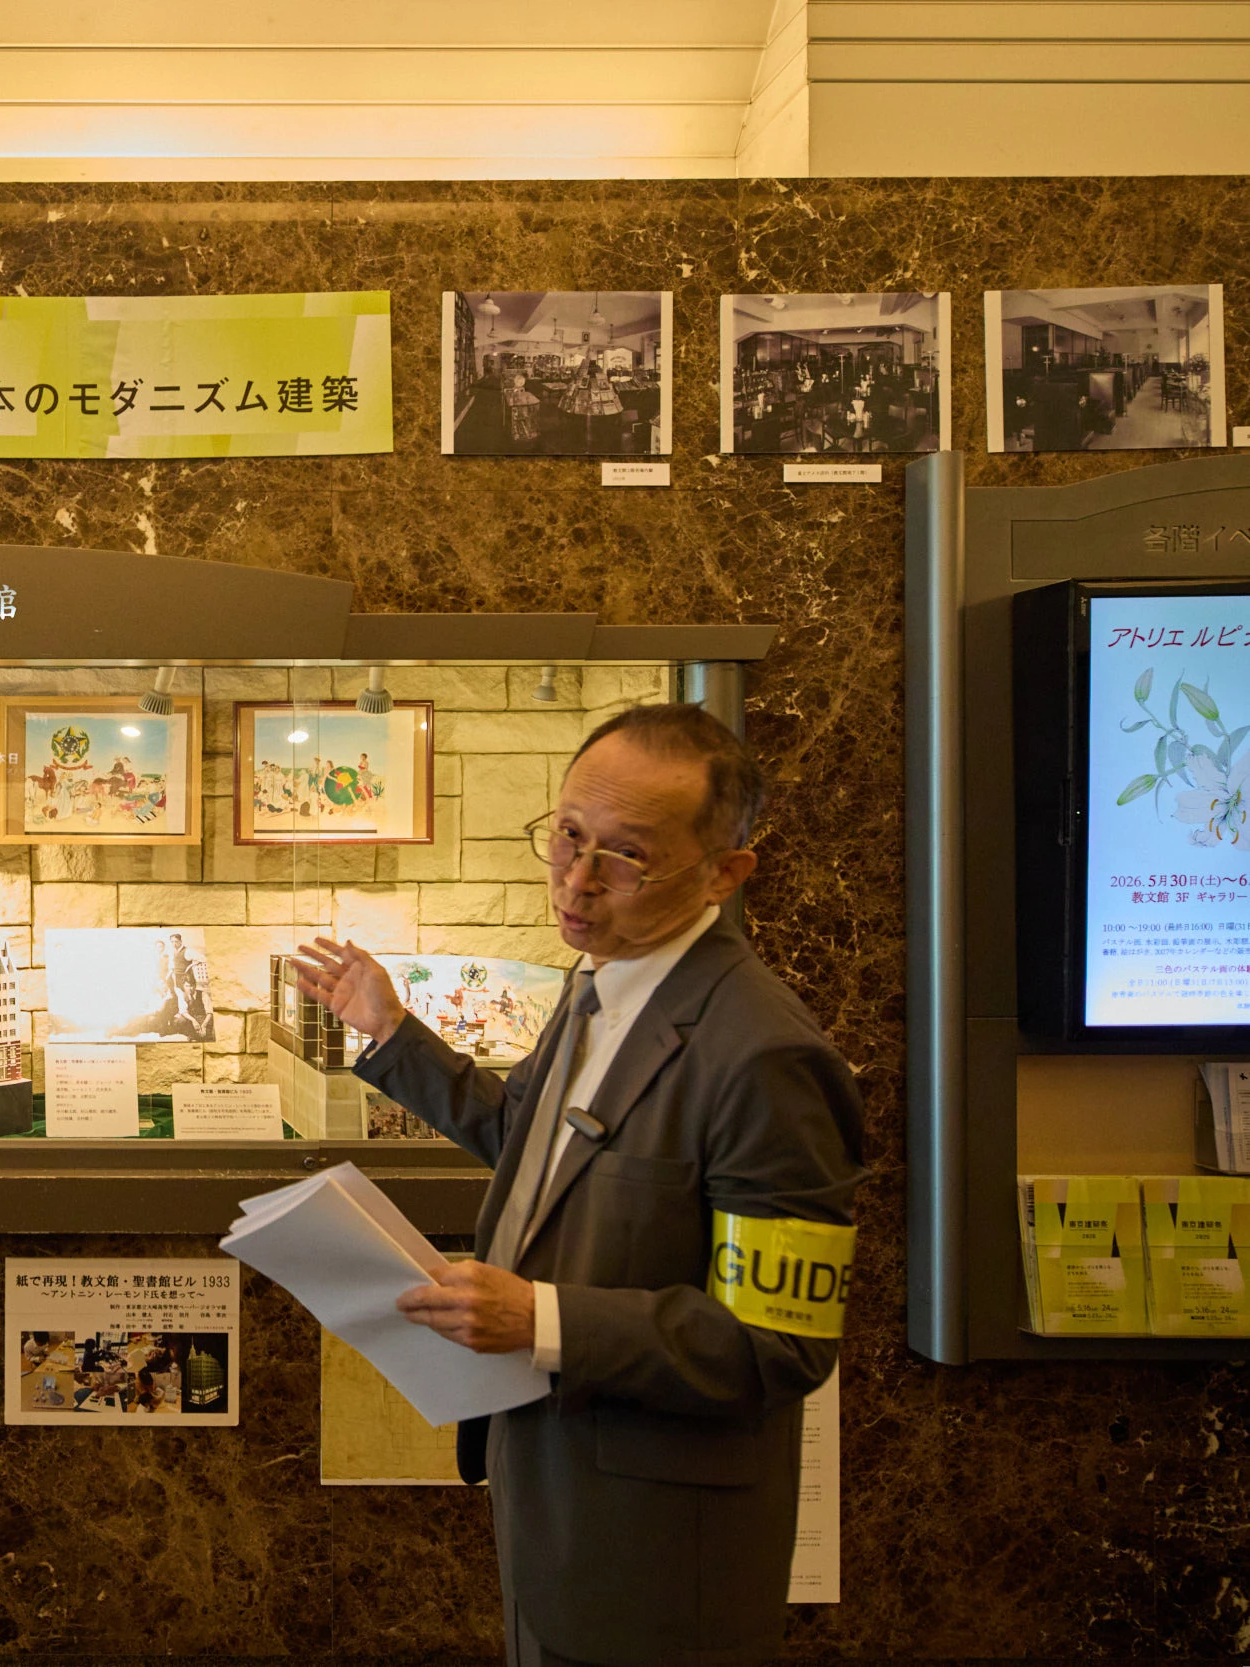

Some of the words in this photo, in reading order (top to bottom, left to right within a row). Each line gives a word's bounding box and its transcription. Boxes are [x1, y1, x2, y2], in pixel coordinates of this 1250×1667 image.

[1132, 891, 1170, 903] 教文館
[1176, 892, 1189, 903] 3F
[1197, 891, 1248, 903] ギャラリー
[715, 1242, 852, 1304] GUIDE
[16, 1275, 197, 1289] 紙で再現！教文館・聖書館ビル
[203, 1276, 231, 1288] 1933
